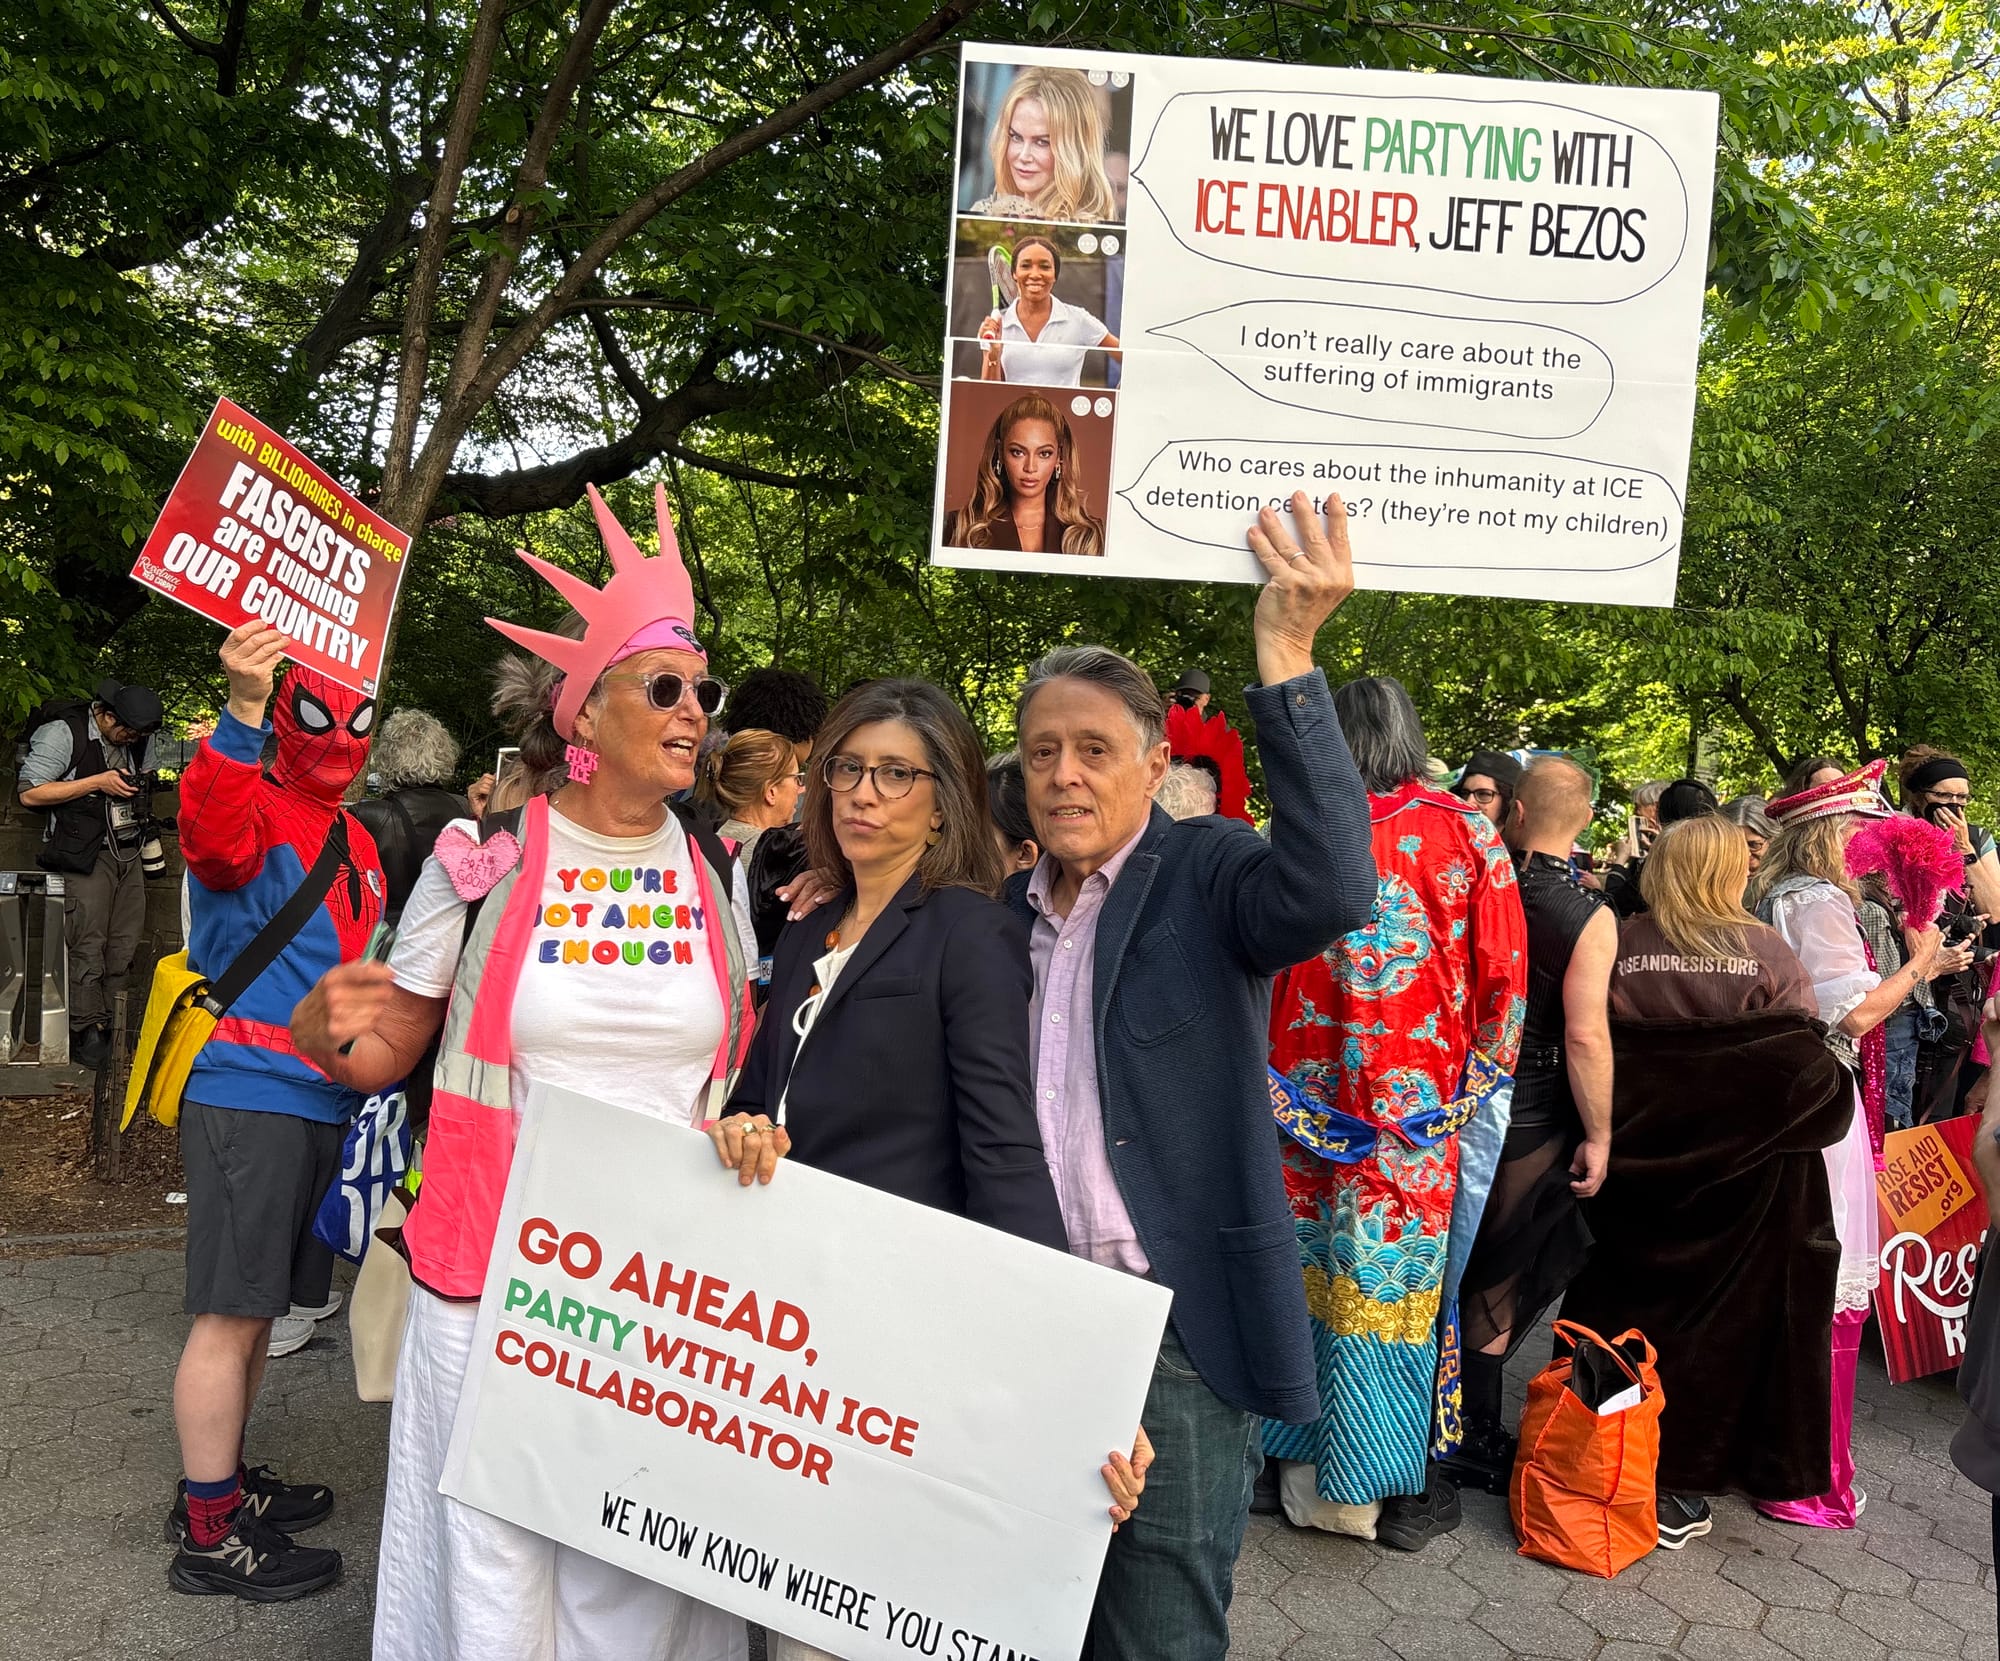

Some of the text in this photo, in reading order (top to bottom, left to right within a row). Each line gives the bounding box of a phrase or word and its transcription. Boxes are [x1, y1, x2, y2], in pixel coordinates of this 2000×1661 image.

[1210, 106, 1634, 190] WE LOVE PARTYING WITH
[1195, 178, 1648, 263] ICE ENABLER, JEFF BEZOS
[1240, 325, 1581, 370] I don't really care about the
[1264, 362, 1553, 400] suffering of immigrants
[216, 418, 402, 562] with BILLIONAIRES in charge
[1179, 450, 1644, 499] Who cares about the inhumanity at ICE
[219, 460, 371, 595] FASCISTS
[1146, 486, 1668, 542] detention cetes? (they're not my children)
[162, 532, 369, 670] OUR COUNTRY
[213, 516, 359, 627] are running
[567, 763, 590, 785] ICE
[557, 867, 678, 894] YOU'RE
[602, 903, 704, 930] ANGRY
[538, 939, 693, 965] ENOUGH
[1875, 1135, 1939, 1193] RISE AND
[1887, 1153, 1952, 1218] RESIST
[1941, 1180, 1963, 1217] .org
[518, 1217, 819, 1367] GO AHEAD,
[503, 1277, 920, 1458] PARTY WITH AN ICE
[494, 1329, 834, 1487] COLLABORATOR
[600, 1490, 637, 1537] WE
[639, 1507, 698, 1560] NOW
[702, 1532, 780, 1592] KNOW
[785, 1563, 877, 1632] WHERE
[886, 1601, 943, 1656] YOU
